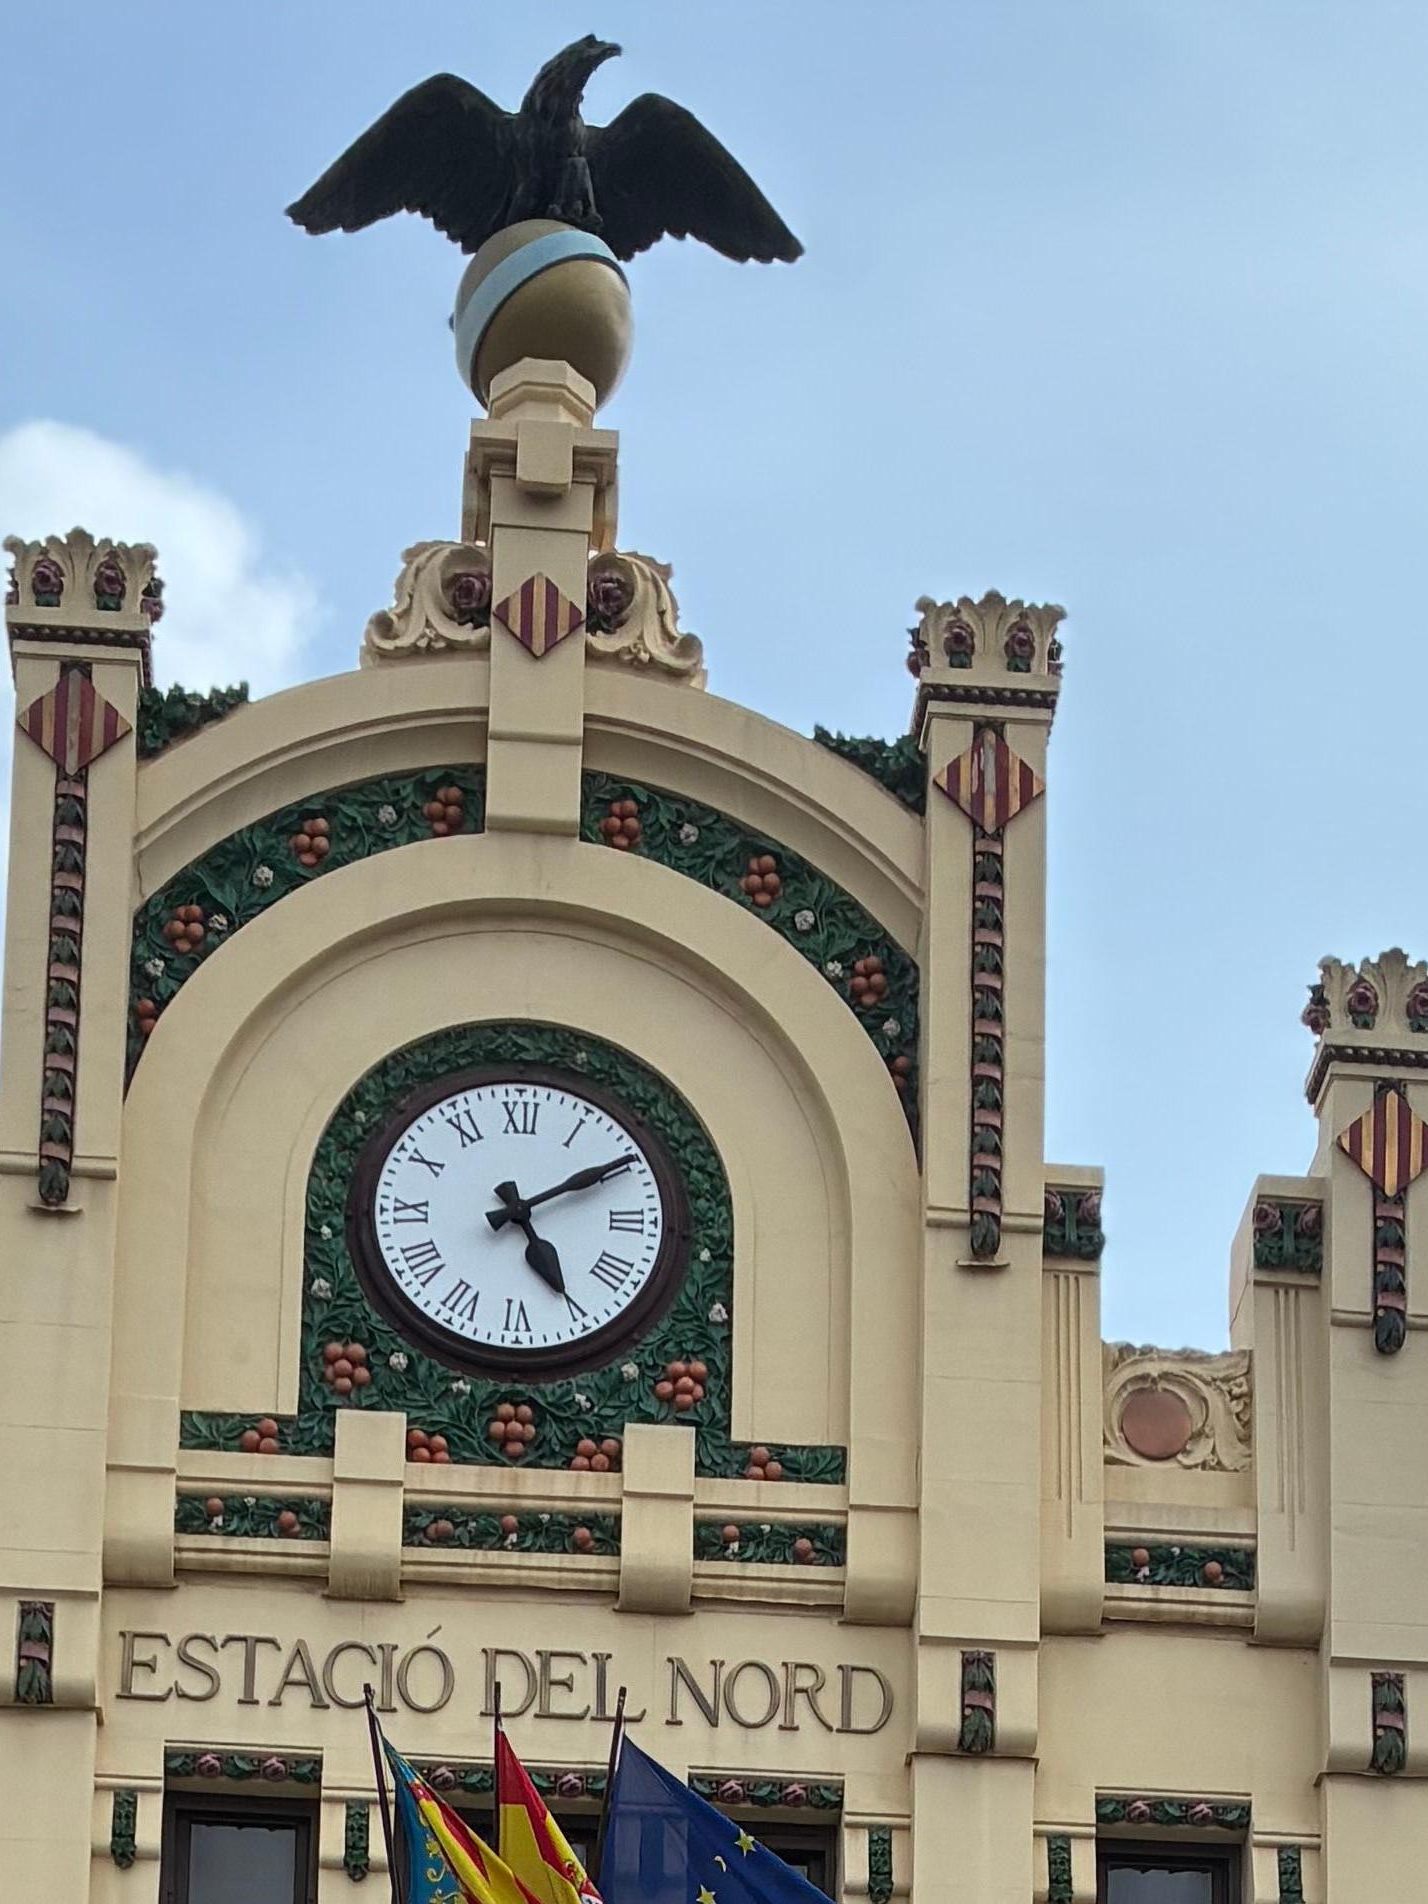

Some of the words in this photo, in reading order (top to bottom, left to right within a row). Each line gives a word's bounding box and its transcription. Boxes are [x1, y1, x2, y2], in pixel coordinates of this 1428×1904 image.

[446, 1109, 484, 1148] XI
[502, 1101, 540, 1135] XII
[562, 1118, 587, 1148] I
[407, 1148, 446, 1178] X
[393, 1197, 429, 1224] IX
[609, 1209, 645, 1234] III
[399, 1238, 447, 1289] VIII
[440, 1278, 481, 1322] VII
[502, 1298, 532, 1333] VI
[114, 1625, 456, 1714] ESTACIÓ
[479, 1647, 647, 1725] DEL
[665, 1655, 895, 1735] NORD
